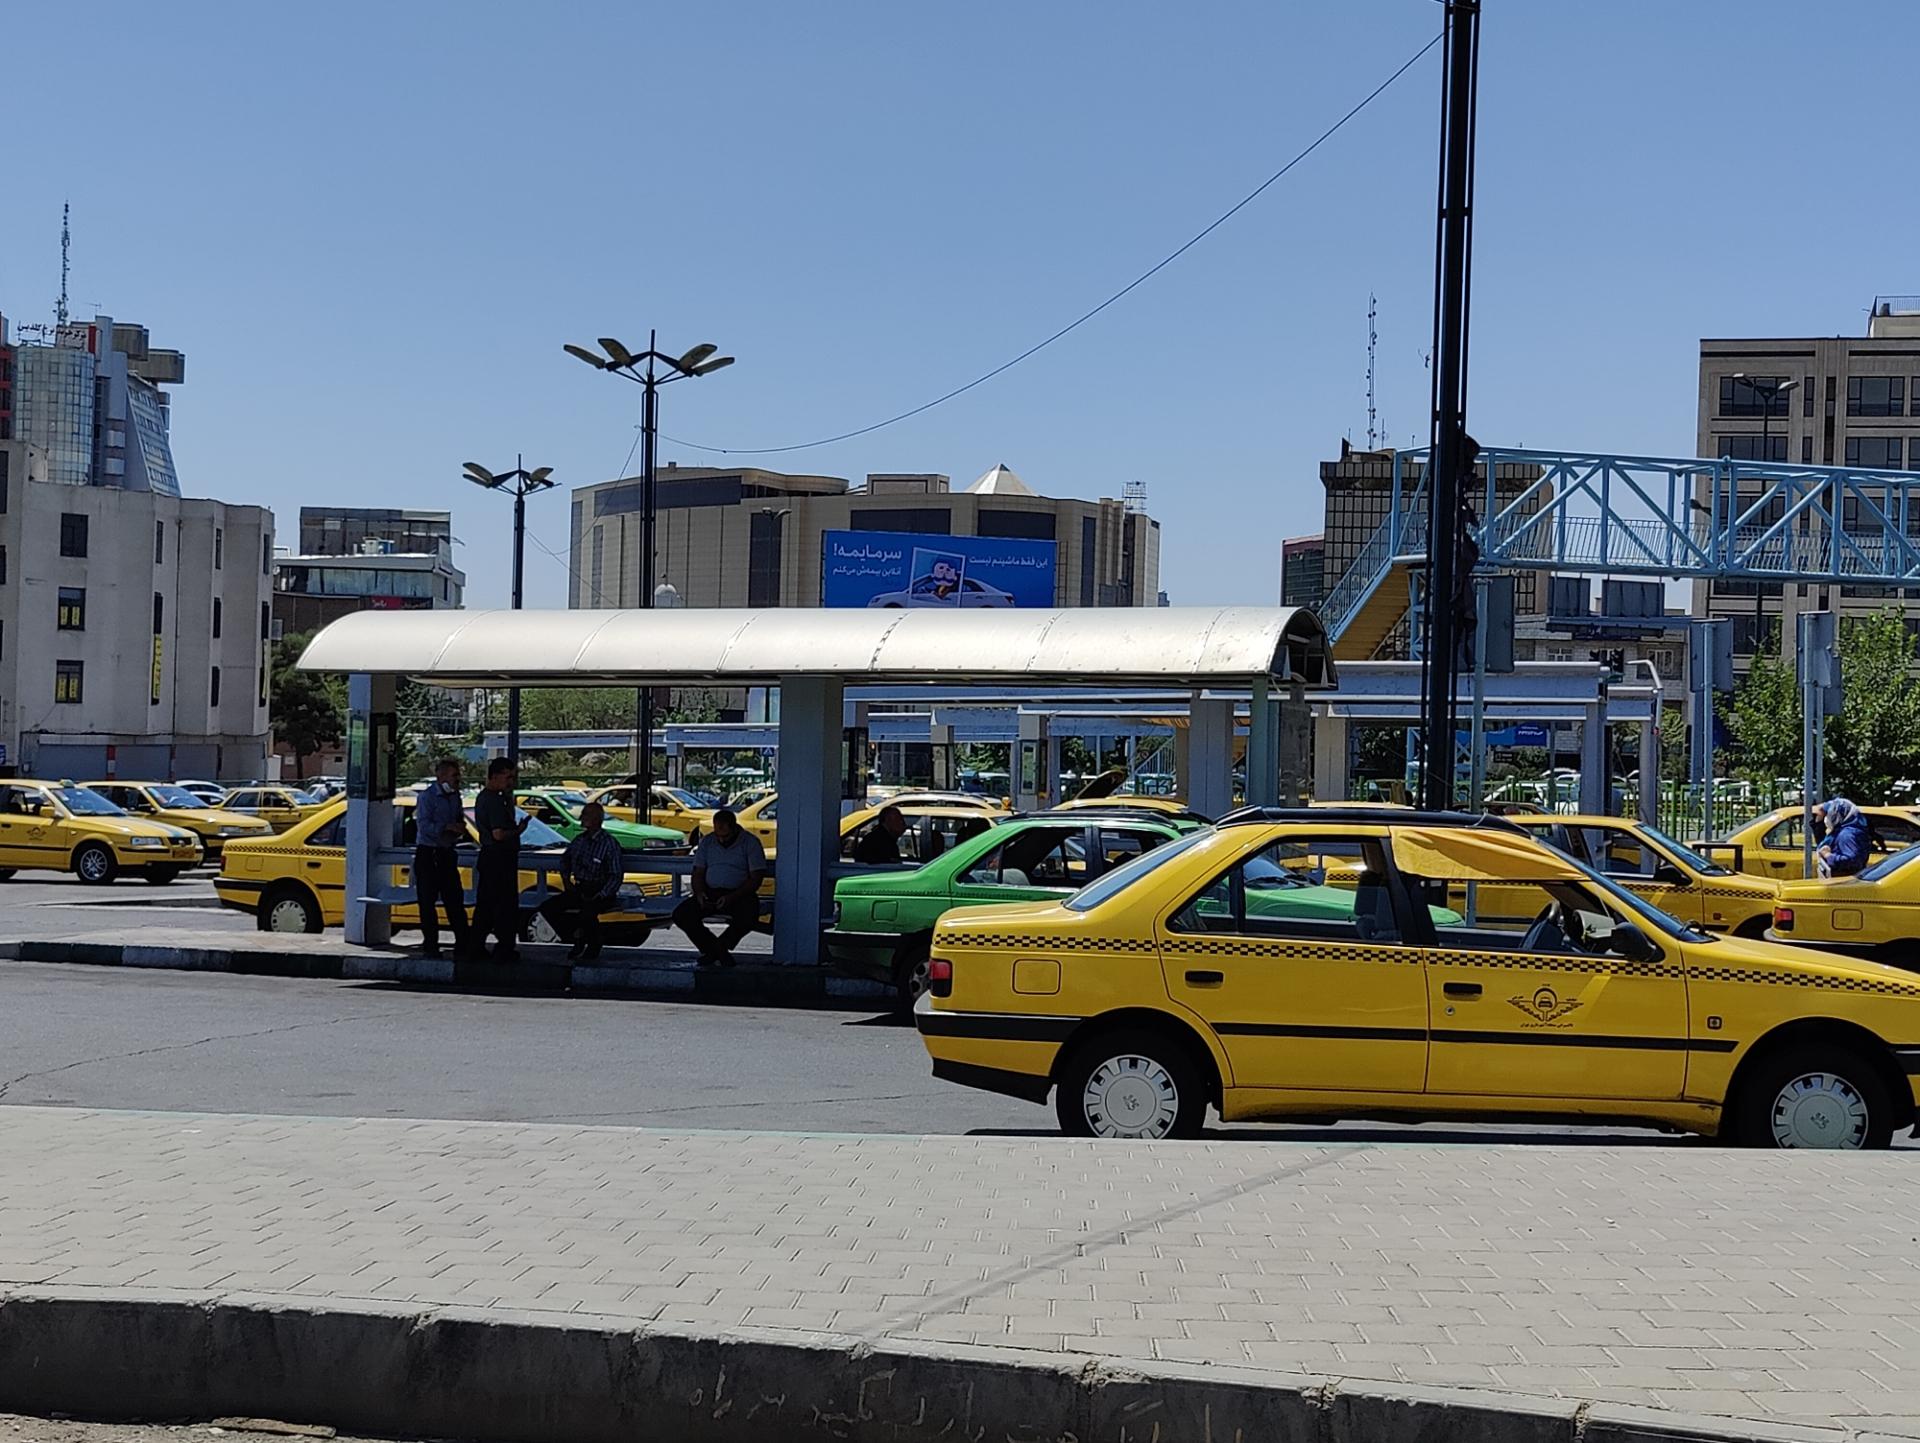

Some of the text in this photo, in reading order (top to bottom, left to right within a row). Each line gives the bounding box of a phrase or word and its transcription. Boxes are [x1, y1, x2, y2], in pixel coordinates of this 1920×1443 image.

[833, 542, 902, 562] سرمایمه!
[969, 555, 1048, 569] این فقط ماشینم نیست
[881, 565, 902, 577] آنلاین
